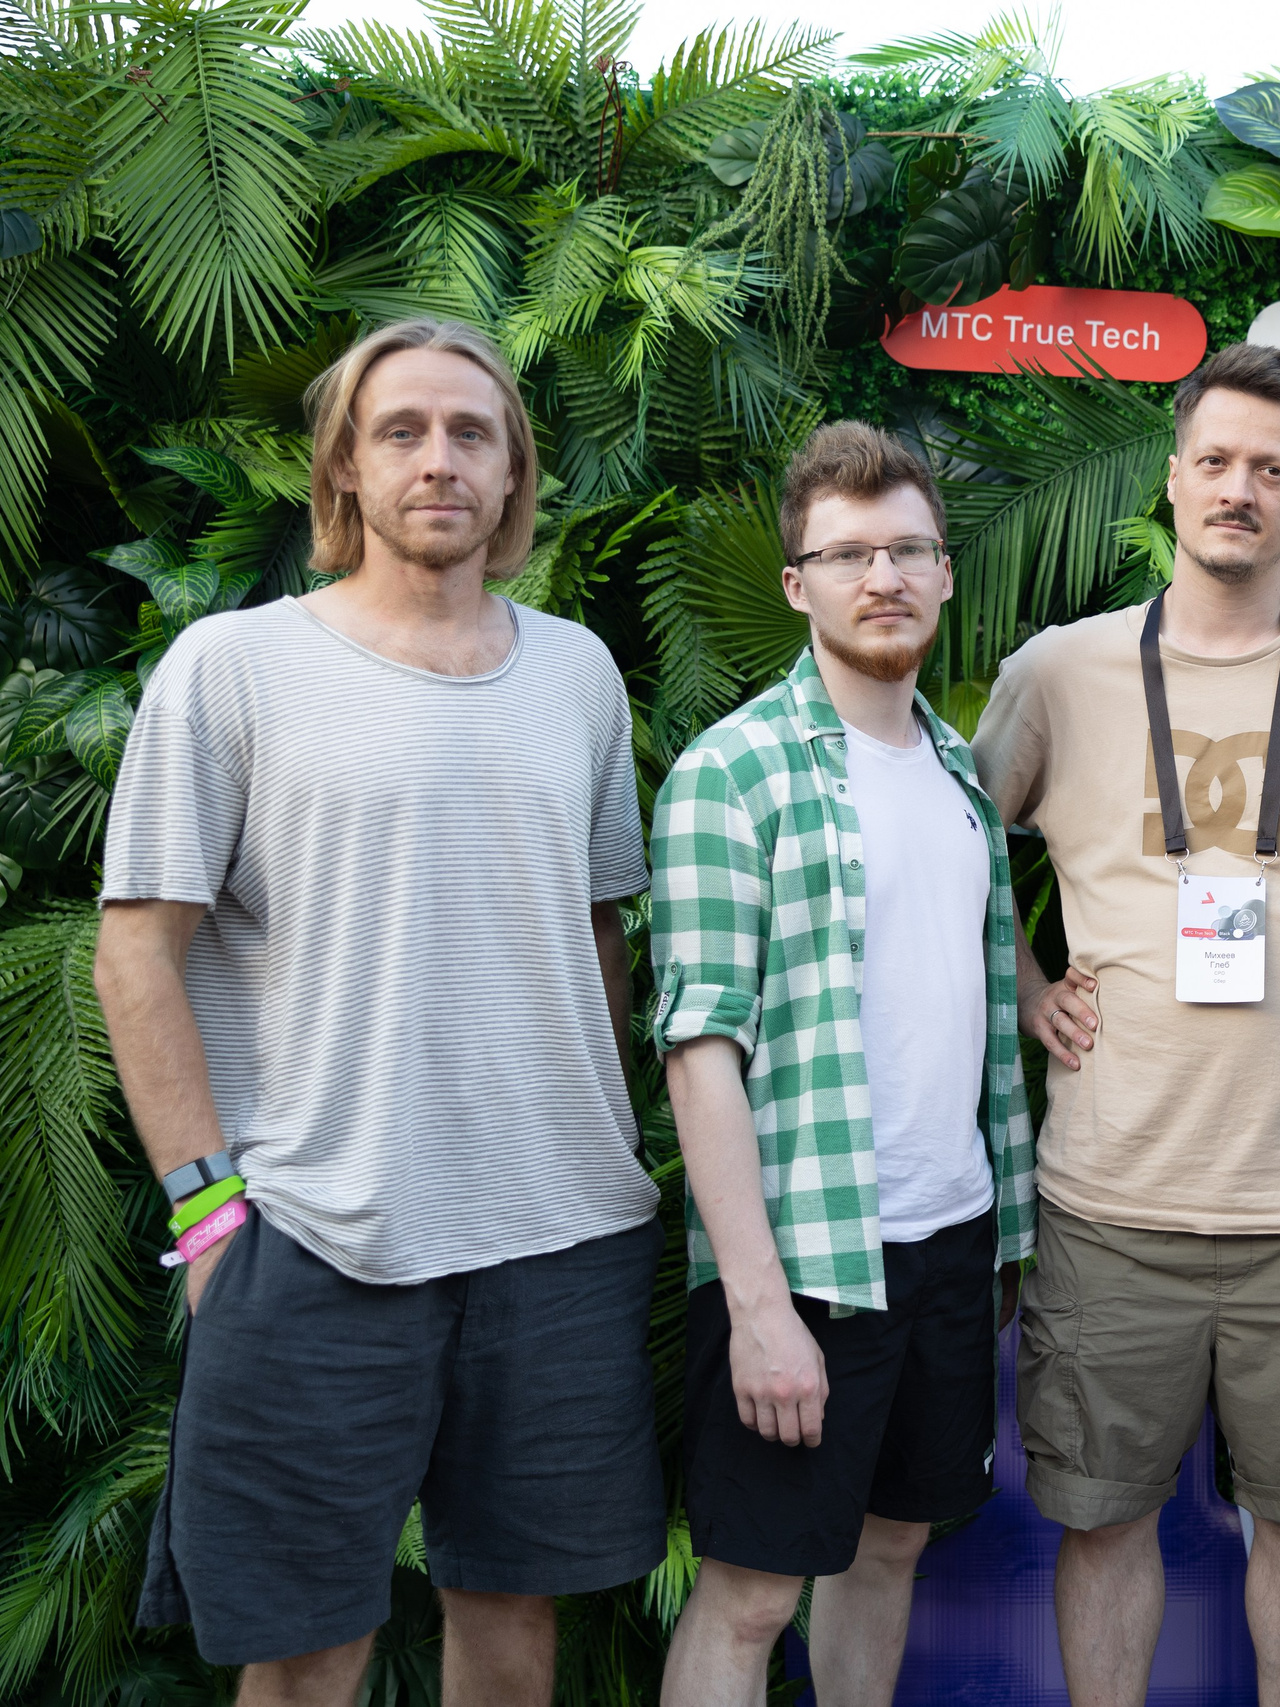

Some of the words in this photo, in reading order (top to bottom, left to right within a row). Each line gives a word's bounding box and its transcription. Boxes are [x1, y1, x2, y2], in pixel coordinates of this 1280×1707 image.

[1003, 315, 1074, 346] True
[1085, 320, 1160, 351] Tech
[1204, 951, 1236, 959] Михеев
[1209, 960, 1230, 969] Глеб
[186, 1207, 236, 1252] РЕЧНОЙ
